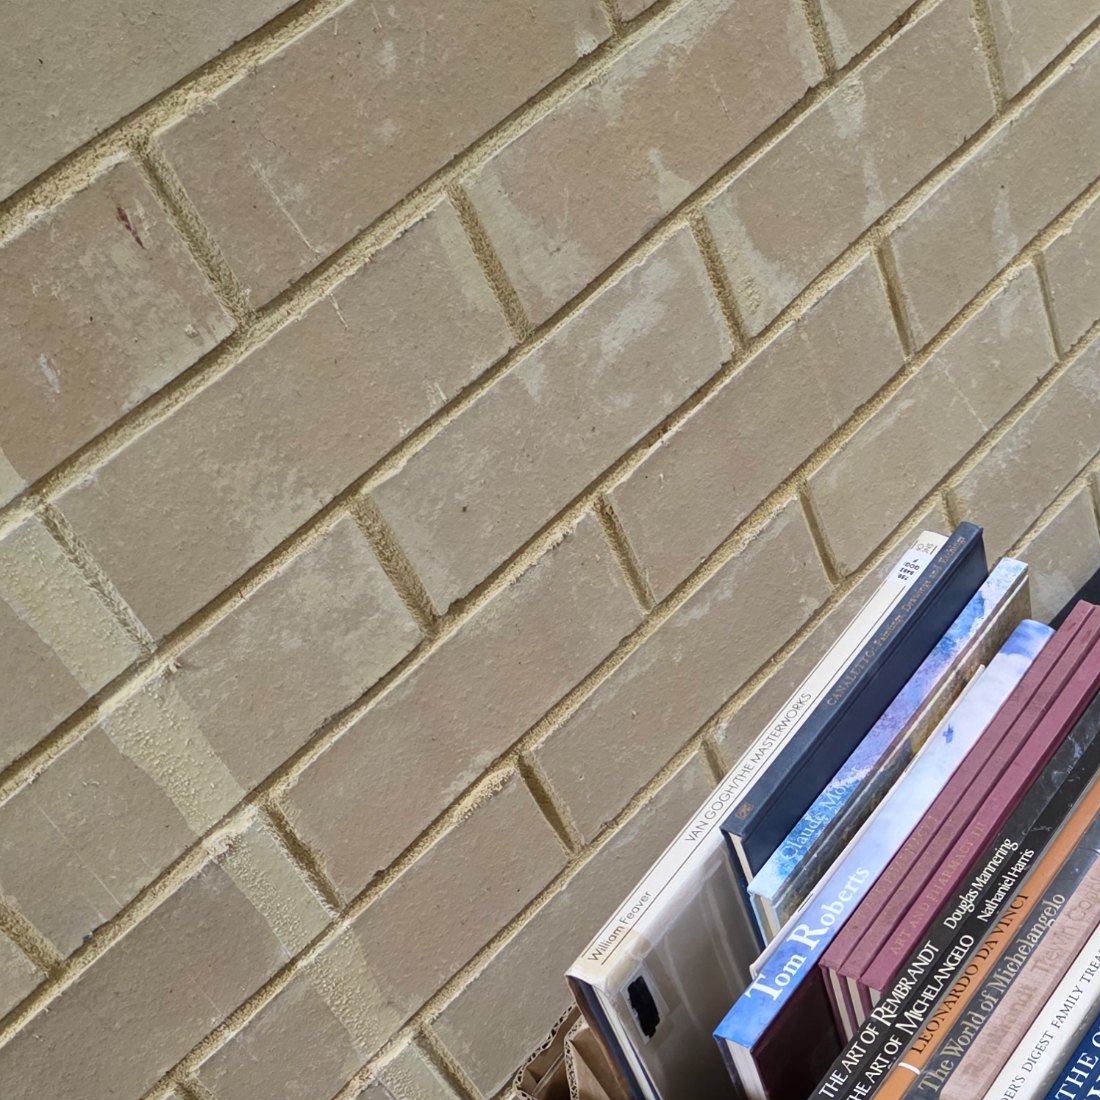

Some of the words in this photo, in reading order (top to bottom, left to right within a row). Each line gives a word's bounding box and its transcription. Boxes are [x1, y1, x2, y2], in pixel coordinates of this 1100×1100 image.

[684, 820, 707, 843] VAN
[704, 765, 753, 824] GOGH/THE
[749, 692, 812, 770] MASTERWORKS
[780, 812, 823, 861] Claude
[943, 885, 980, 931] Douglas
[974, 838, 1019, 891] Mannering
[977, 875, 1012, 923] Nathaniel
[1009, 847, 1035, 884] Harris
[590, 925, 626, 962] William
[620, 890, 652, 932] Feaver
[744, 951, 806, 1001] Tom
[786, 866, 870, 951] Roberts
[910, 964, 979, 1055] LEONARDO
[976, 936, 999, 961] DA
[995, 894, 1029, 938] VINCI
[918, 1062, 956, 1093] The
[948, 1012, 987, 1059] World
[988, 893, 1066, 998] Michelangelo
[819, 1075, 841, 1099] THE
[840, 1047, 863, 1073] ART
[860, 1024, 880, 1047] OF
[871, 939, 940, 1027] REMBRANDT
[865, 1058, 890, 1085] ART
[883, 1037, 903, 1058] OF
[896, 934, 975, 1037] MICHELANGELO
[1021, 1030, 1051, 1073] DIGEST
[1050, 985, 1084, 1030] FAMILY
